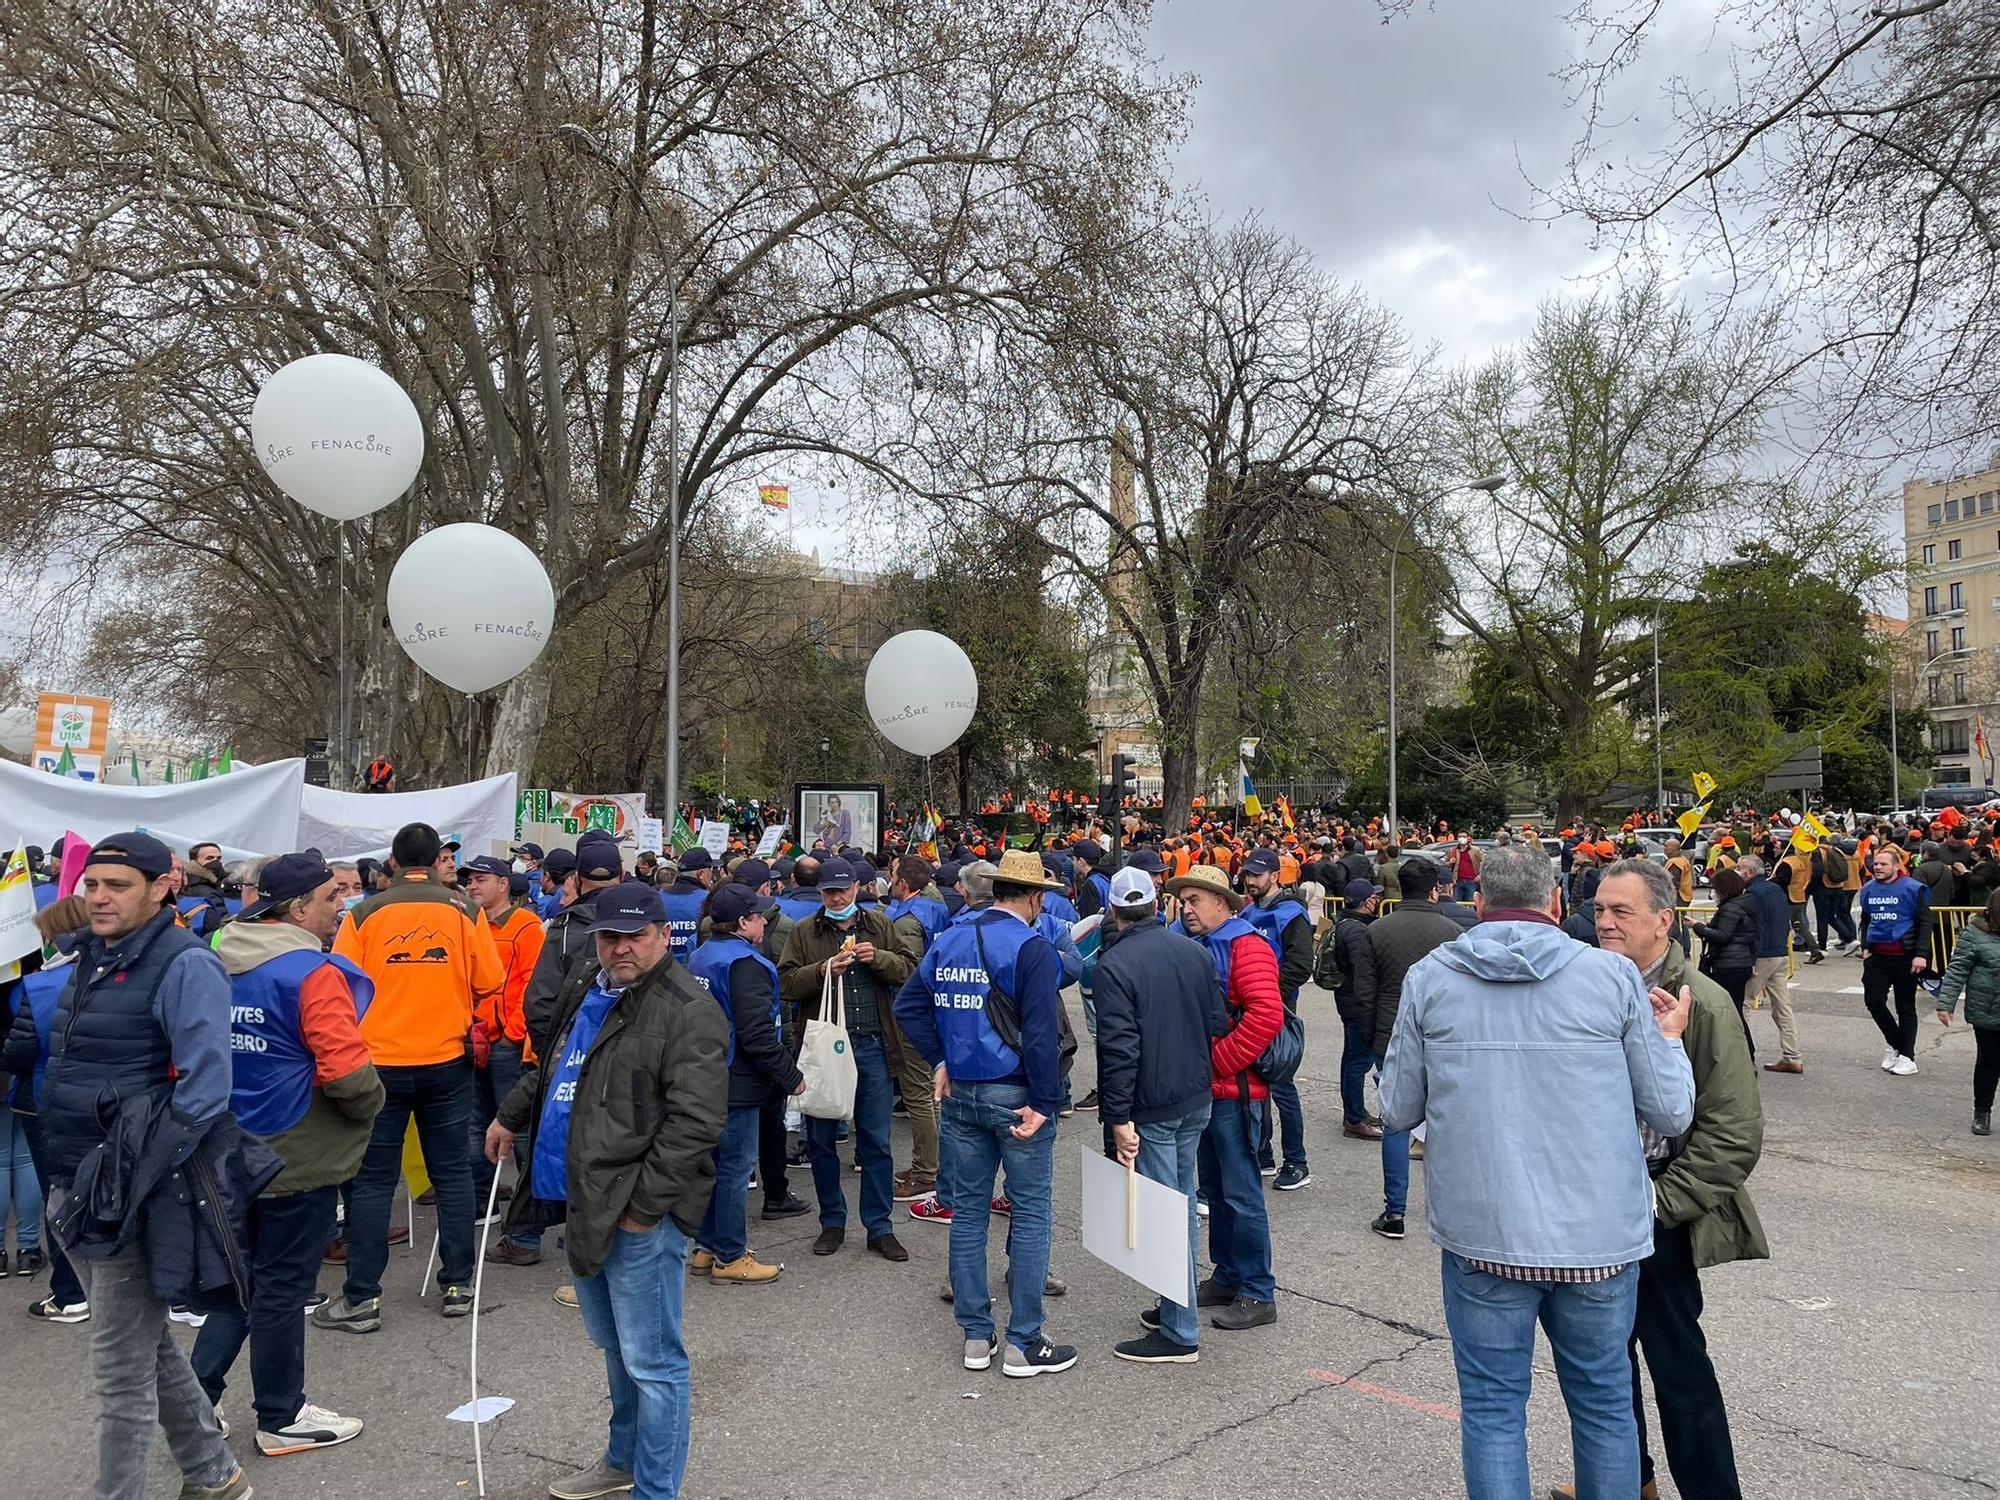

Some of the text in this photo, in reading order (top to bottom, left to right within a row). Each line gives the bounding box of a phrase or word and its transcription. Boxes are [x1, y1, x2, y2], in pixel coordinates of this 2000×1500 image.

[311, 434, 393, 457] FENACORE
[474, 620, 543, 642] FENACORE
[59, 731, 82, 742] UPA
